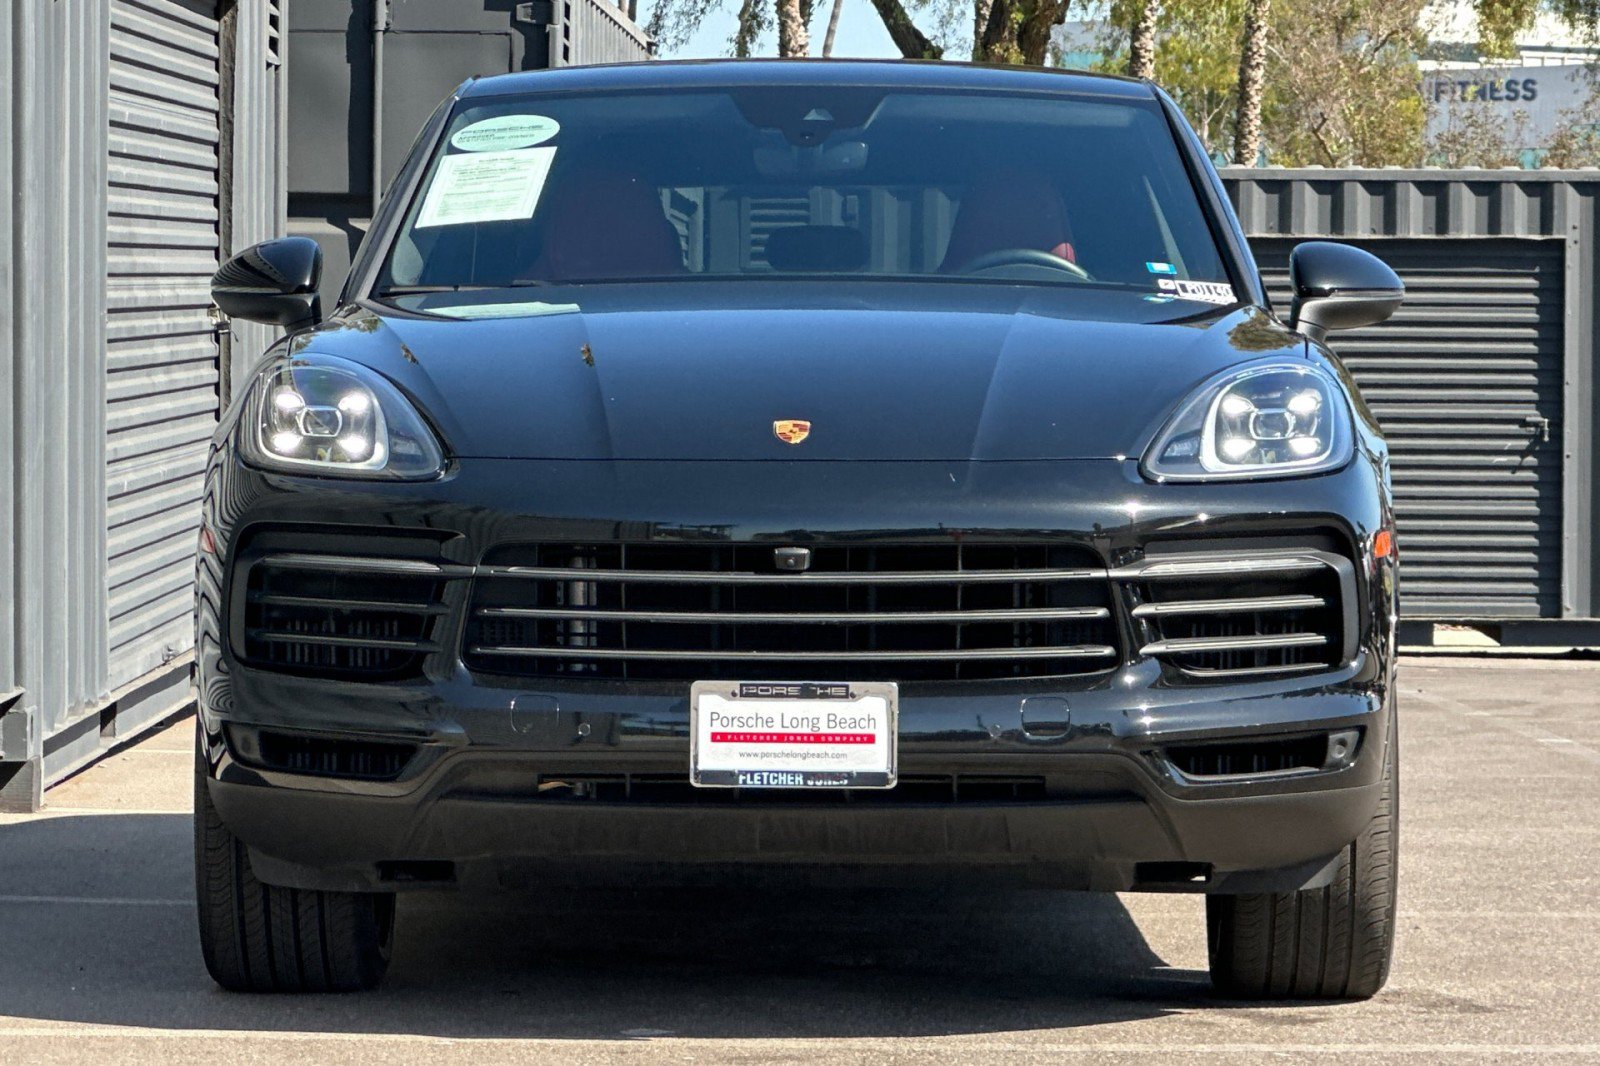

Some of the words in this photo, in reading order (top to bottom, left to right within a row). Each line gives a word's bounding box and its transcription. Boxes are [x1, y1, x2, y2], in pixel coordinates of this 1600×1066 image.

[1434, 79, 1538, 102] FITNESS
[742, 686, 847, 696] PORSHE
[710, 711, 774, 728] Porsche
[781, 712, 821, 733] Long
[826, 713, 876, 729] Beach
[738, 751, 848, 760] www.porschelongbeach.com
[738, 772, 804, 785] FLETCHER
